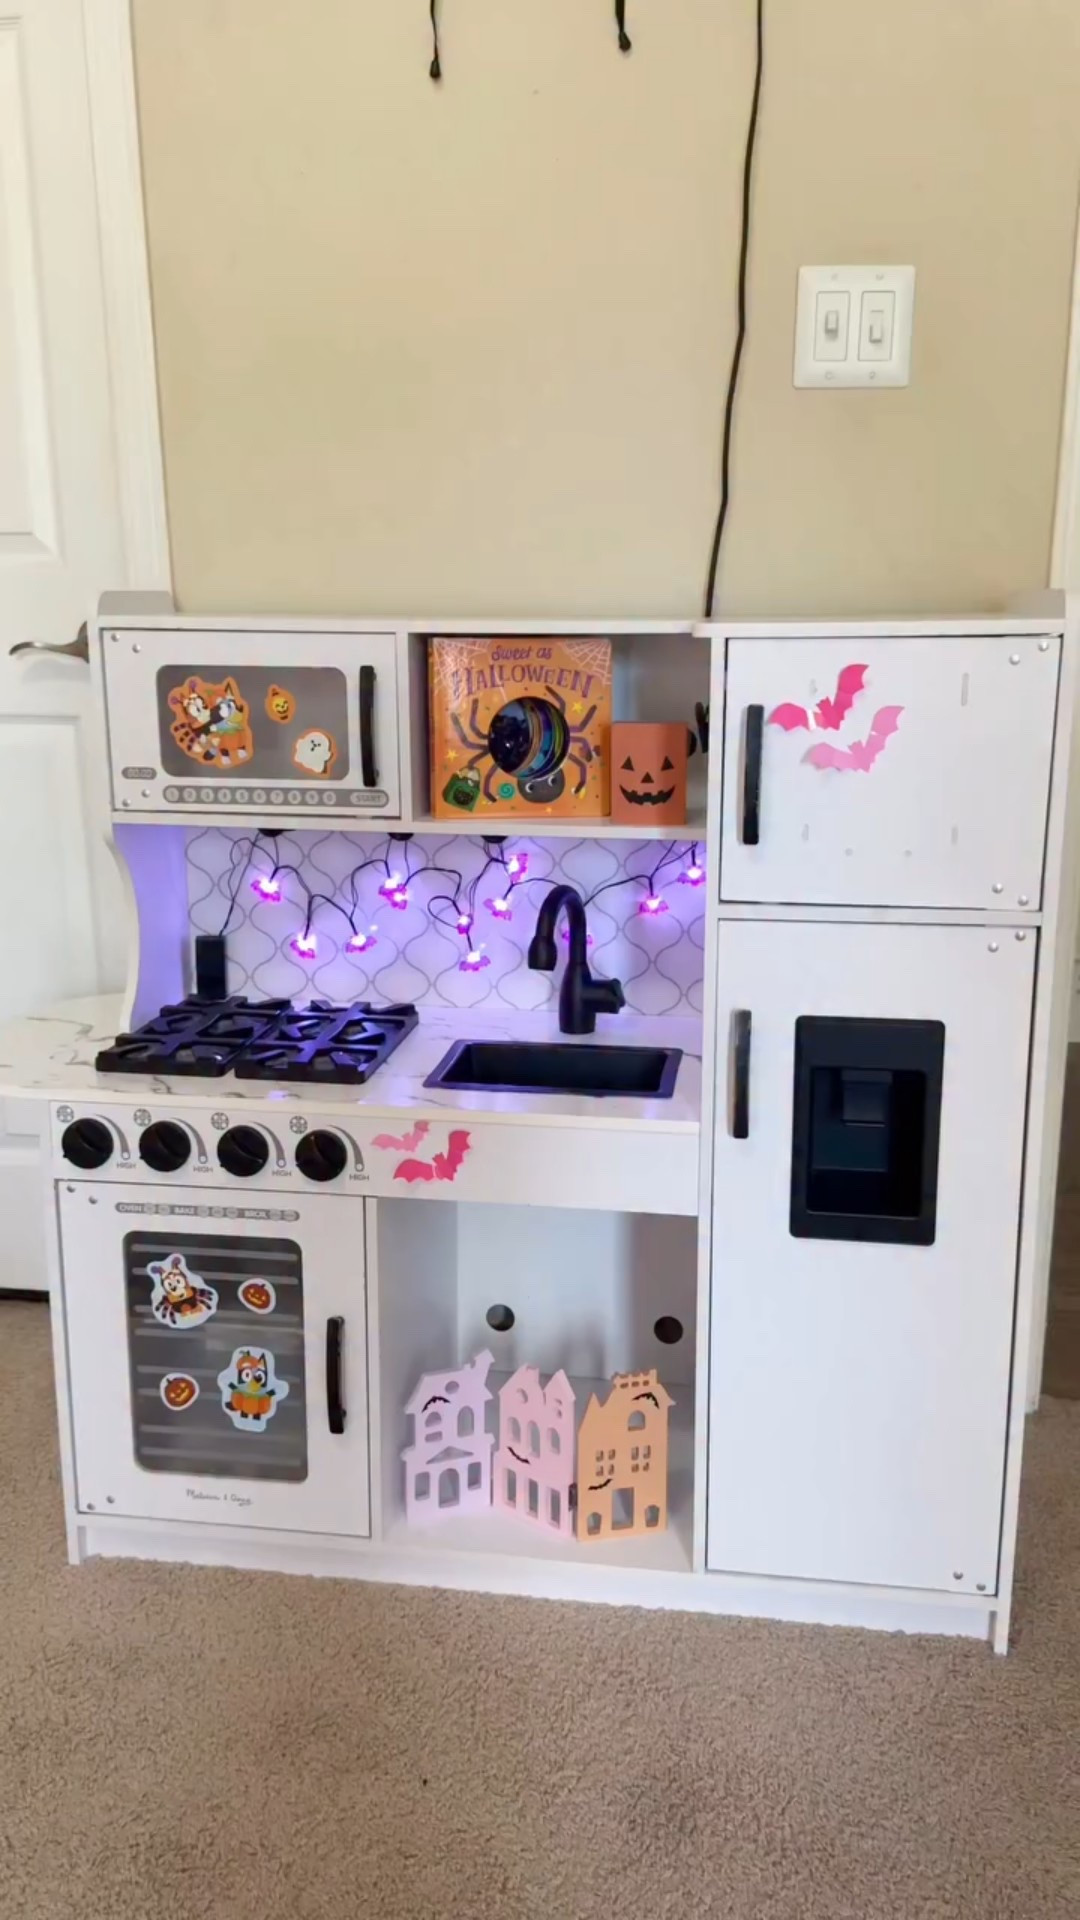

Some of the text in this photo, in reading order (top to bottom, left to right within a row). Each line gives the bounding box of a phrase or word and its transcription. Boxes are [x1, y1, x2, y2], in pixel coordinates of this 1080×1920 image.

[491, 645, 553, 661] Sweet as
[452, 663, 595, 699] HALLOWEEN
[271, 1169, 291, 1177] HIGH
[349, 1173, 369, 1181] HIGH
[119, 1204, 143, 1213] OVEN
